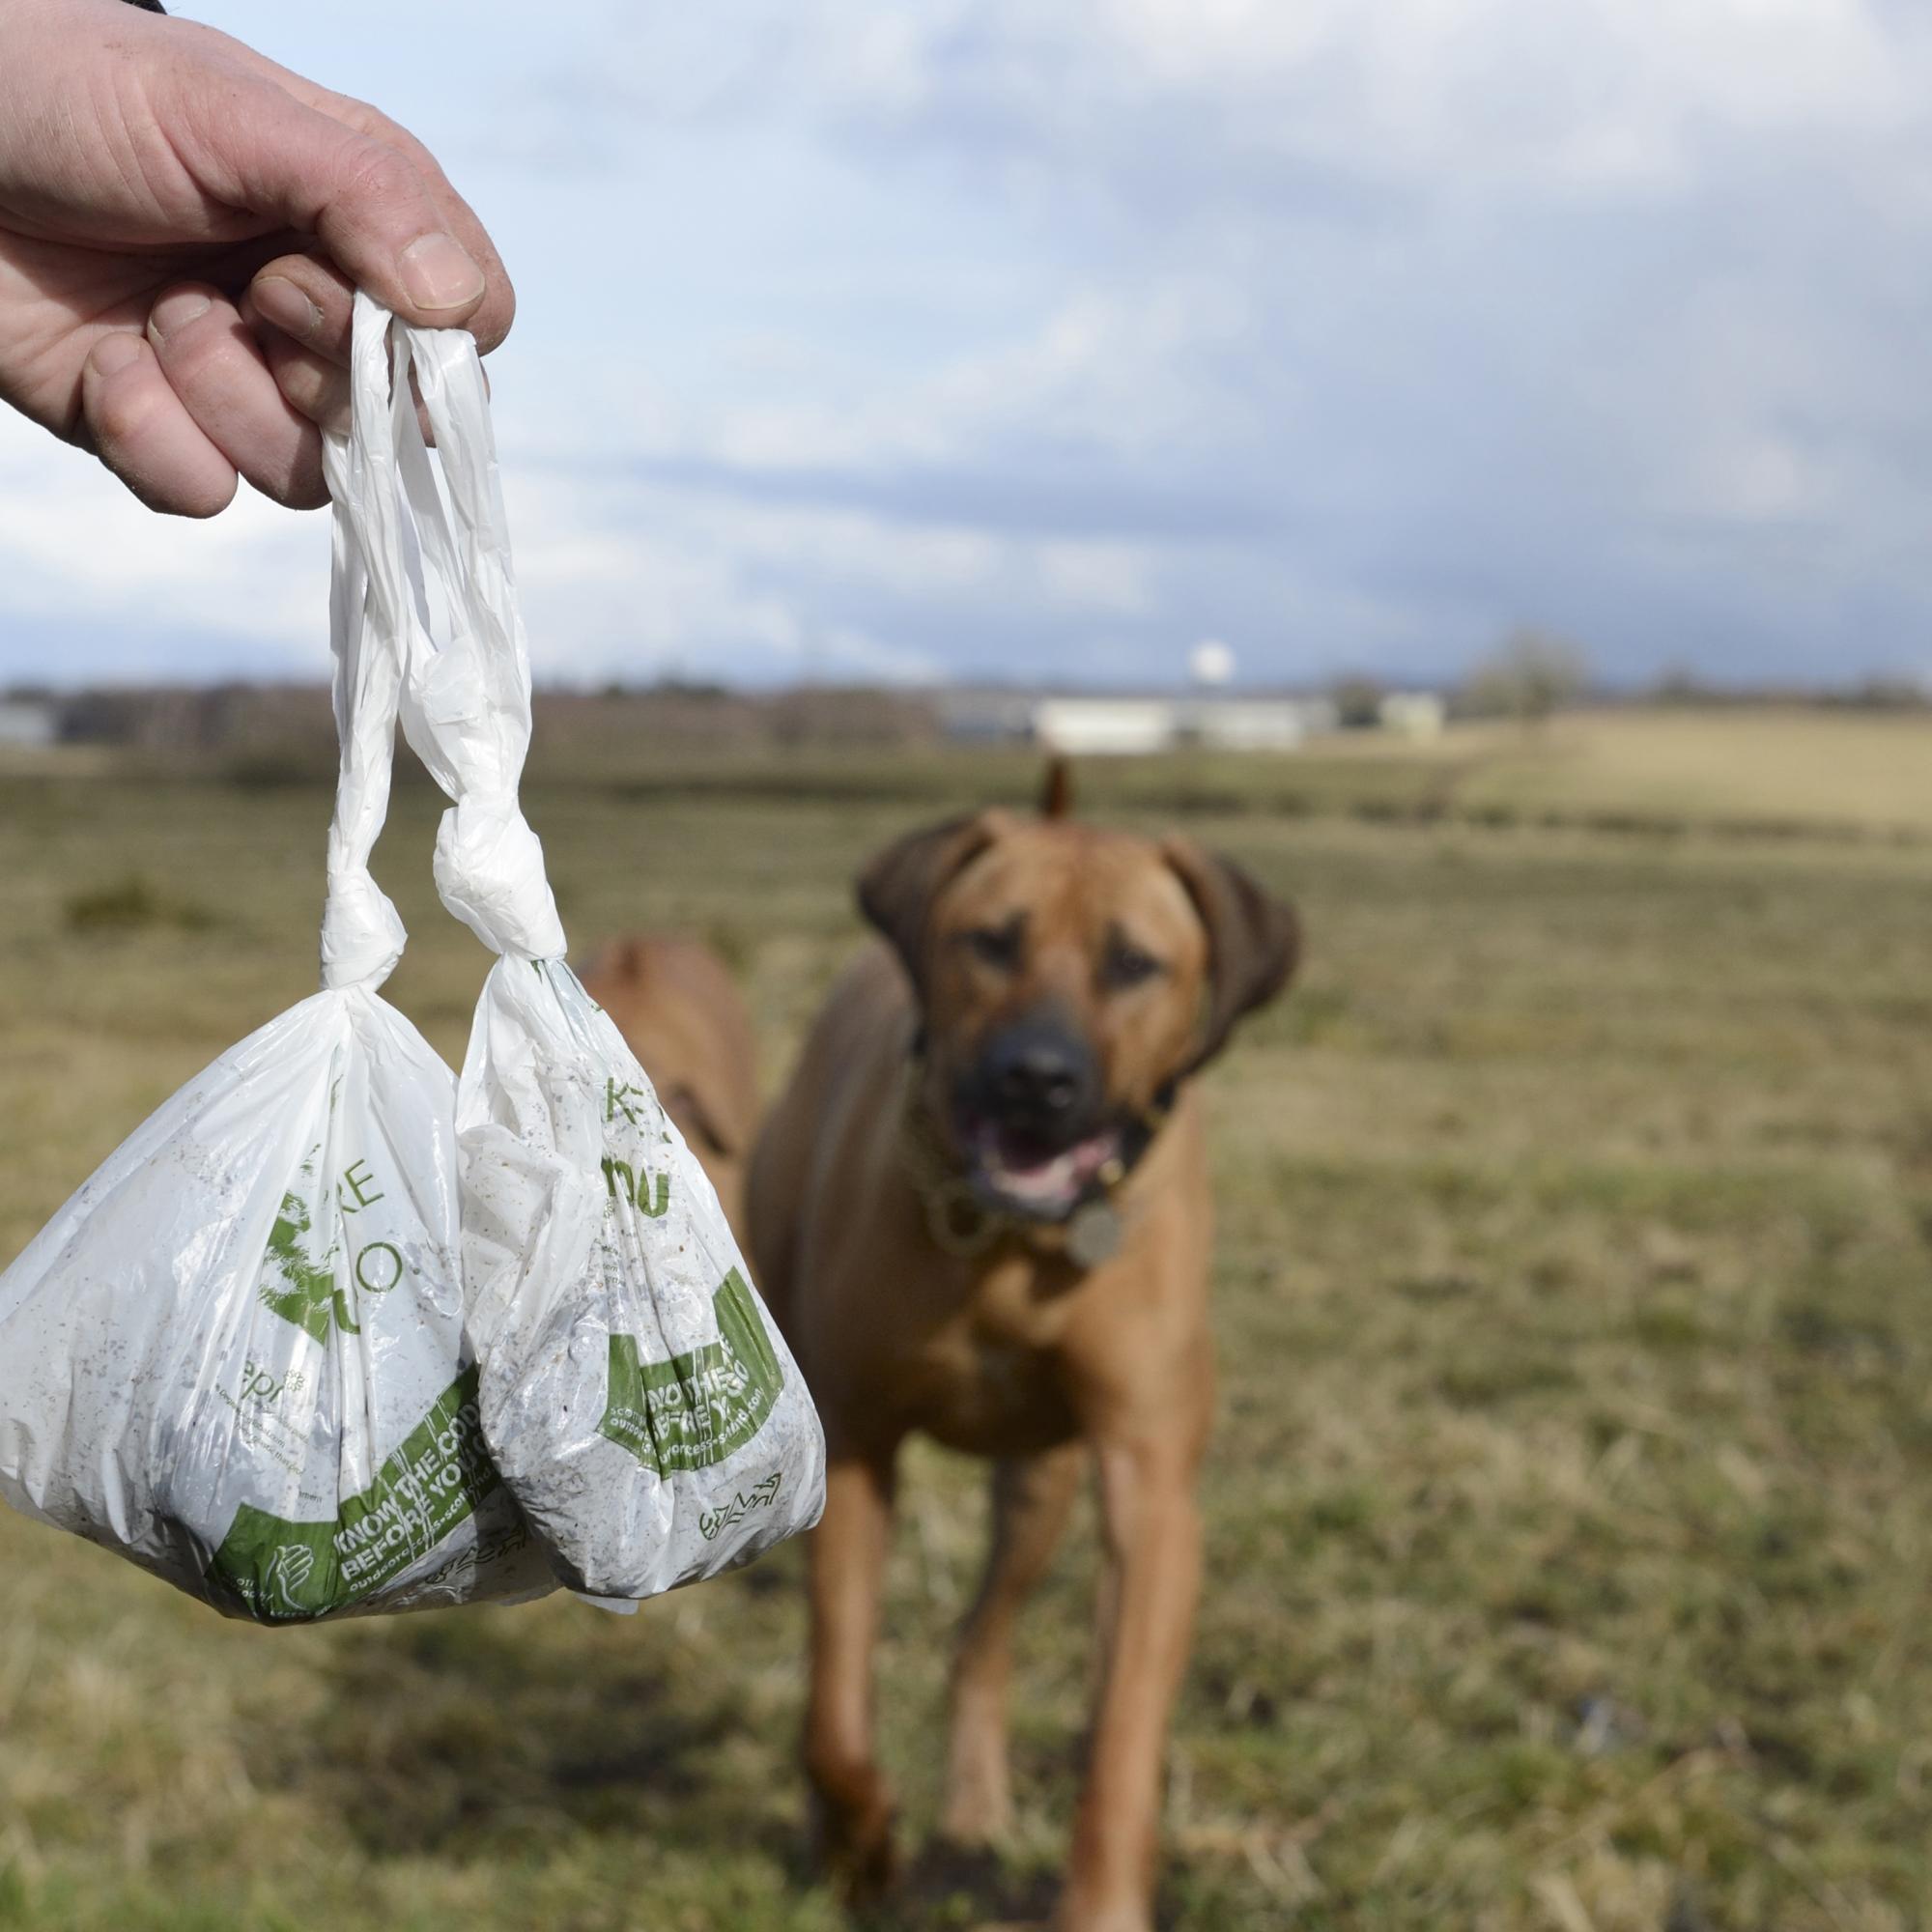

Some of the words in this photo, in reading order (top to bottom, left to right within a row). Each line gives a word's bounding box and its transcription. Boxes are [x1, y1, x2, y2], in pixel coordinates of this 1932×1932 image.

[333, 1493, 402, 1555] KNOW
[393, 1448, 440, 1499] THE
[438, 1394, 480, 1455] COD
[341, 1493, 435, 1581] BEFORE
